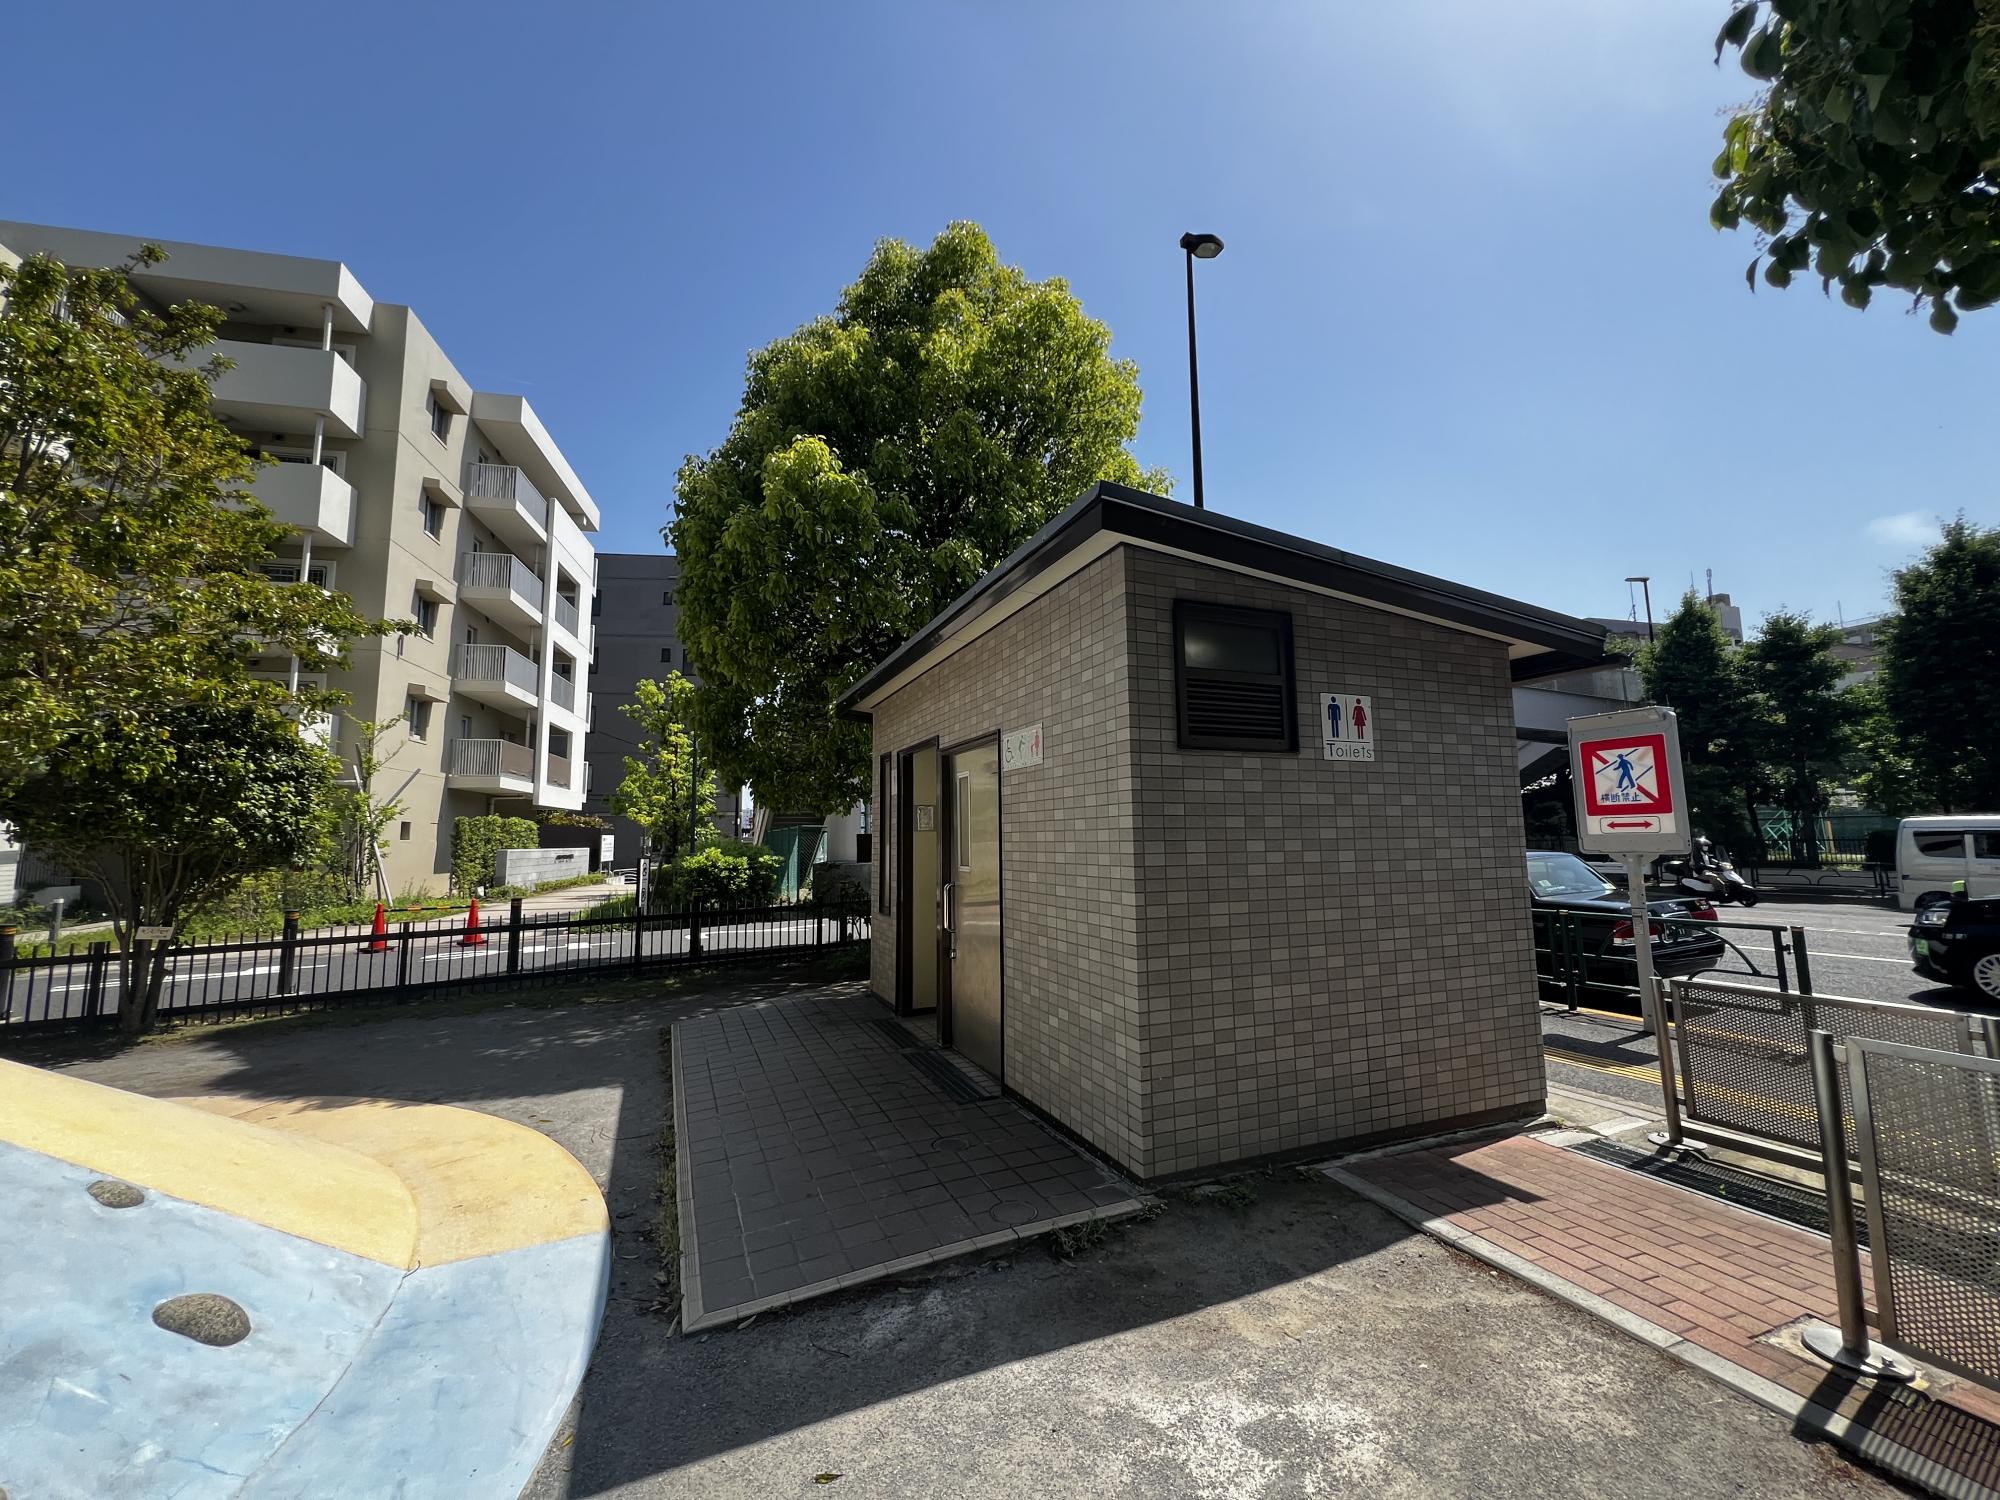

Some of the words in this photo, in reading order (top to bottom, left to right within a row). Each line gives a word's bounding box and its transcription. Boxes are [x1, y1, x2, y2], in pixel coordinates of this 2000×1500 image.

[1326, 742, 1372, 759] Toilets
[1600, 792, 1641, 803] 横断禁止
